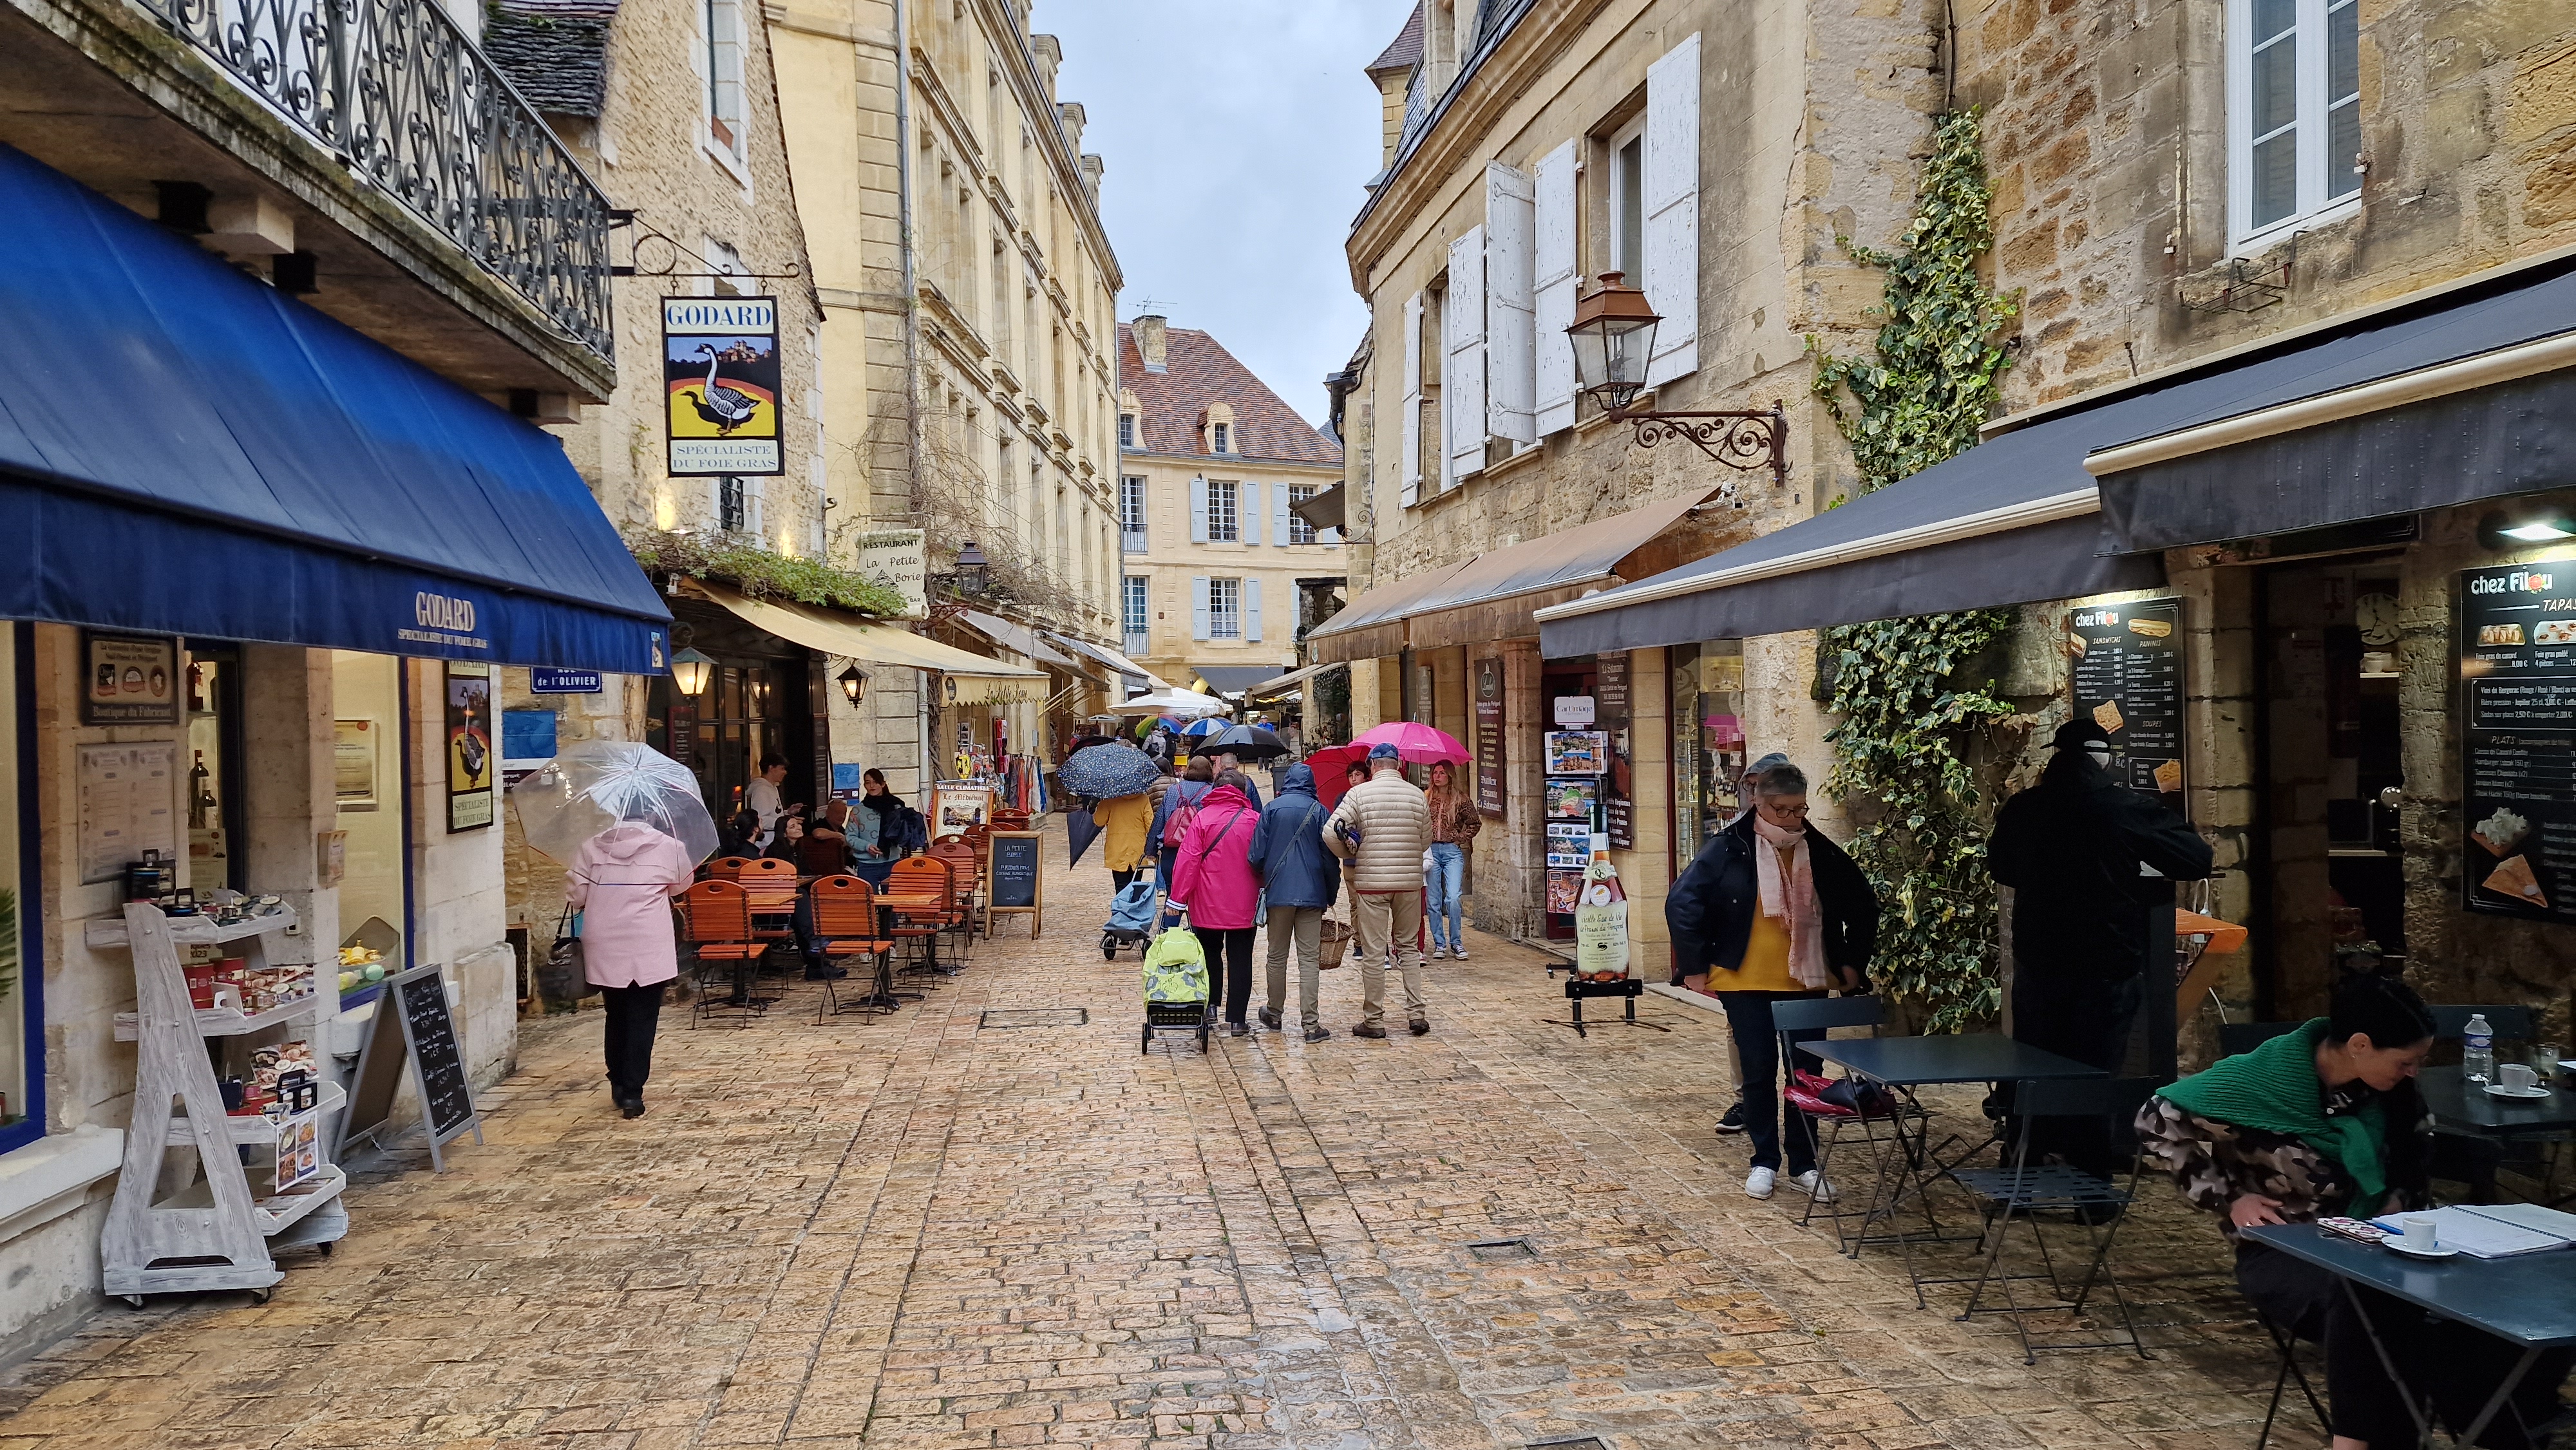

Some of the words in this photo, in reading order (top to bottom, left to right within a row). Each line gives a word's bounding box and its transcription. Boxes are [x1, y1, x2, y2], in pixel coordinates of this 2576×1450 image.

[667, 305, 771, 326] GODARD
[677, 444, 771, 455] SPÉCIALISTE
[674, 459, 693, 467] DU
[699, 459, 733, 467] FOIE
[737, 459, 777, 467] GRAS
[864, 540, 918, 549] RESTAURANT
[866, 559, 880, 568] La
[889, 556, 919, 567] Petite
[894, 572, 923, 583] Borie
[2471, 576, 2506, 595] chez
[2510, 570, 2553, 594] Filou
[415, 591, 475, 632] GODARD
[2076, 613, 2094, 627] chez
[2095, 610, 2119, 626] Filou
[538, 677, 547, 686] de
[453, 816, 460, 826] DU
[463, 814, 476, 824] FOIE
[477, 813, 491, 822] GRAS
[1581, 913, 1596, 923] Vieille
[1597, 914, 1607, 923] Eau
